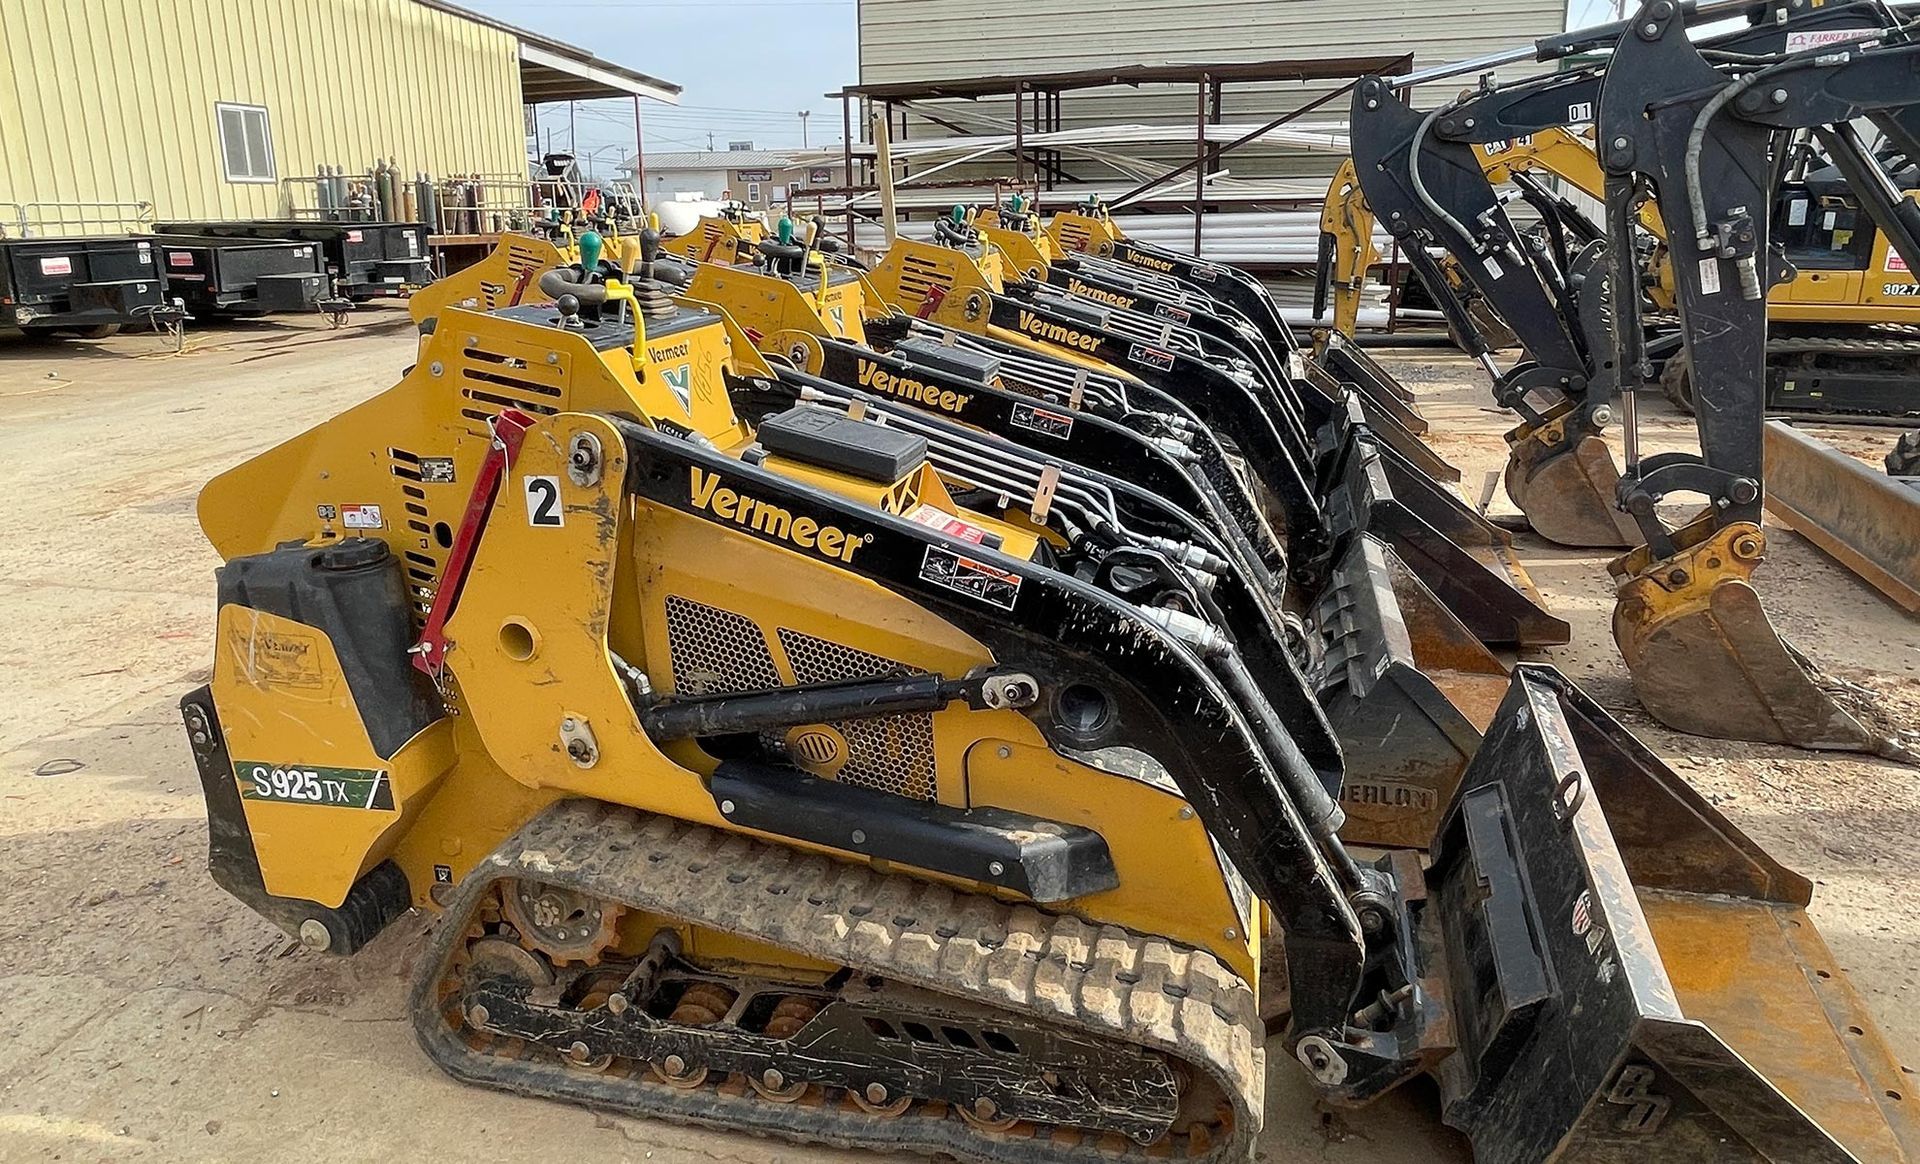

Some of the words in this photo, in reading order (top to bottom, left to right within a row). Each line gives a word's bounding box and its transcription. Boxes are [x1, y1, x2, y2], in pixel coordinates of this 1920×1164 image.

[1126, 248, 1174, 272] Vermeer
[1068, 277, 1134, 309] Vermeer
[1019, 309, 1101, 352] Vermeer
[648, 344, 689, 363] Vermeer
[858, 358, 969, 413] Vermeer
[528, 478, 561, 526] 2
[690, 466, 864, 564] Vermeer
